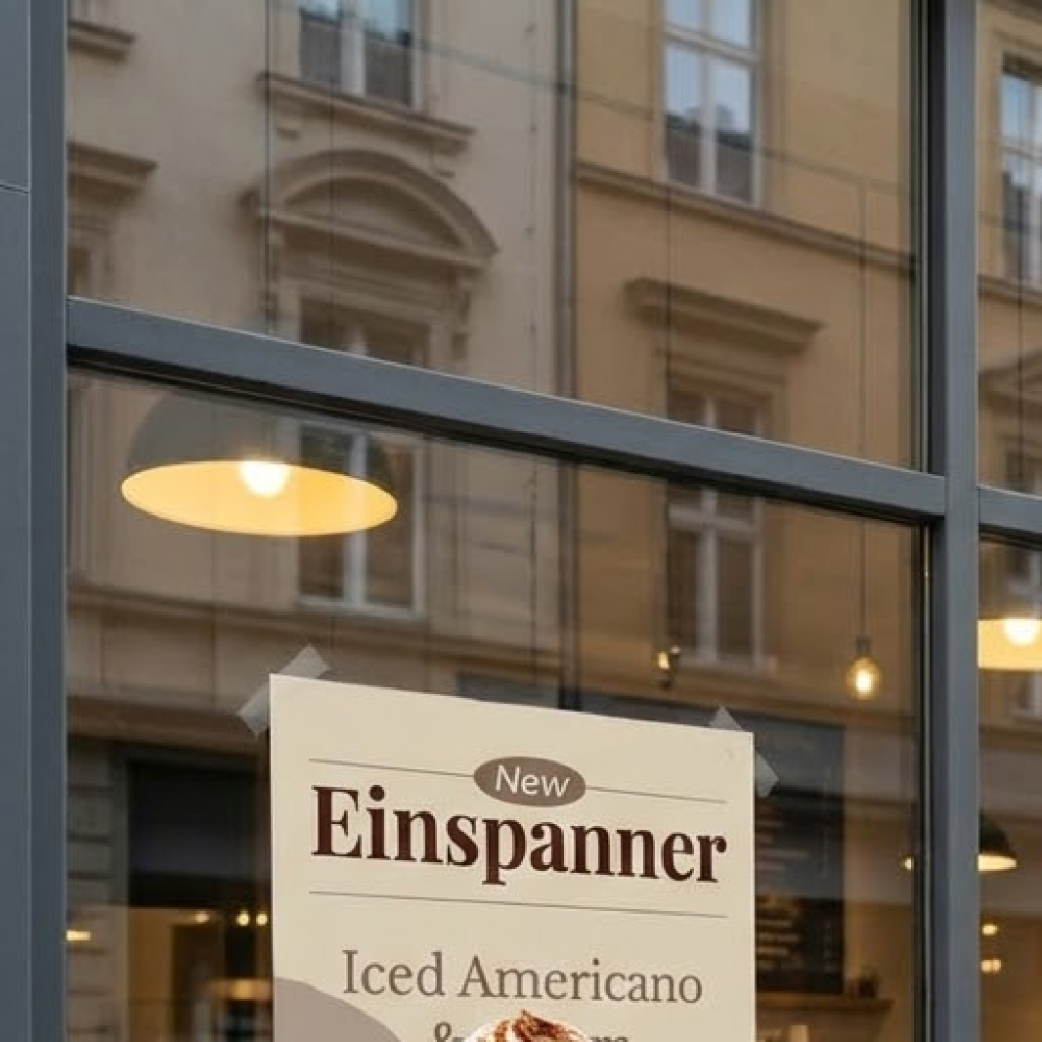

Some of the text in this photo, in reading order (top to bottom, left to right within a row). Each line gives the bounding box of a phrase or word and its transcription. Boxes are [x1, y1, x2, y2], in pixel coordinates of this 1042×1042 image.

[494, 765, 570, 798] New
[311, 784, 728, 886] Einspanner
[342, 949, 704, 1004] Iced Americano
